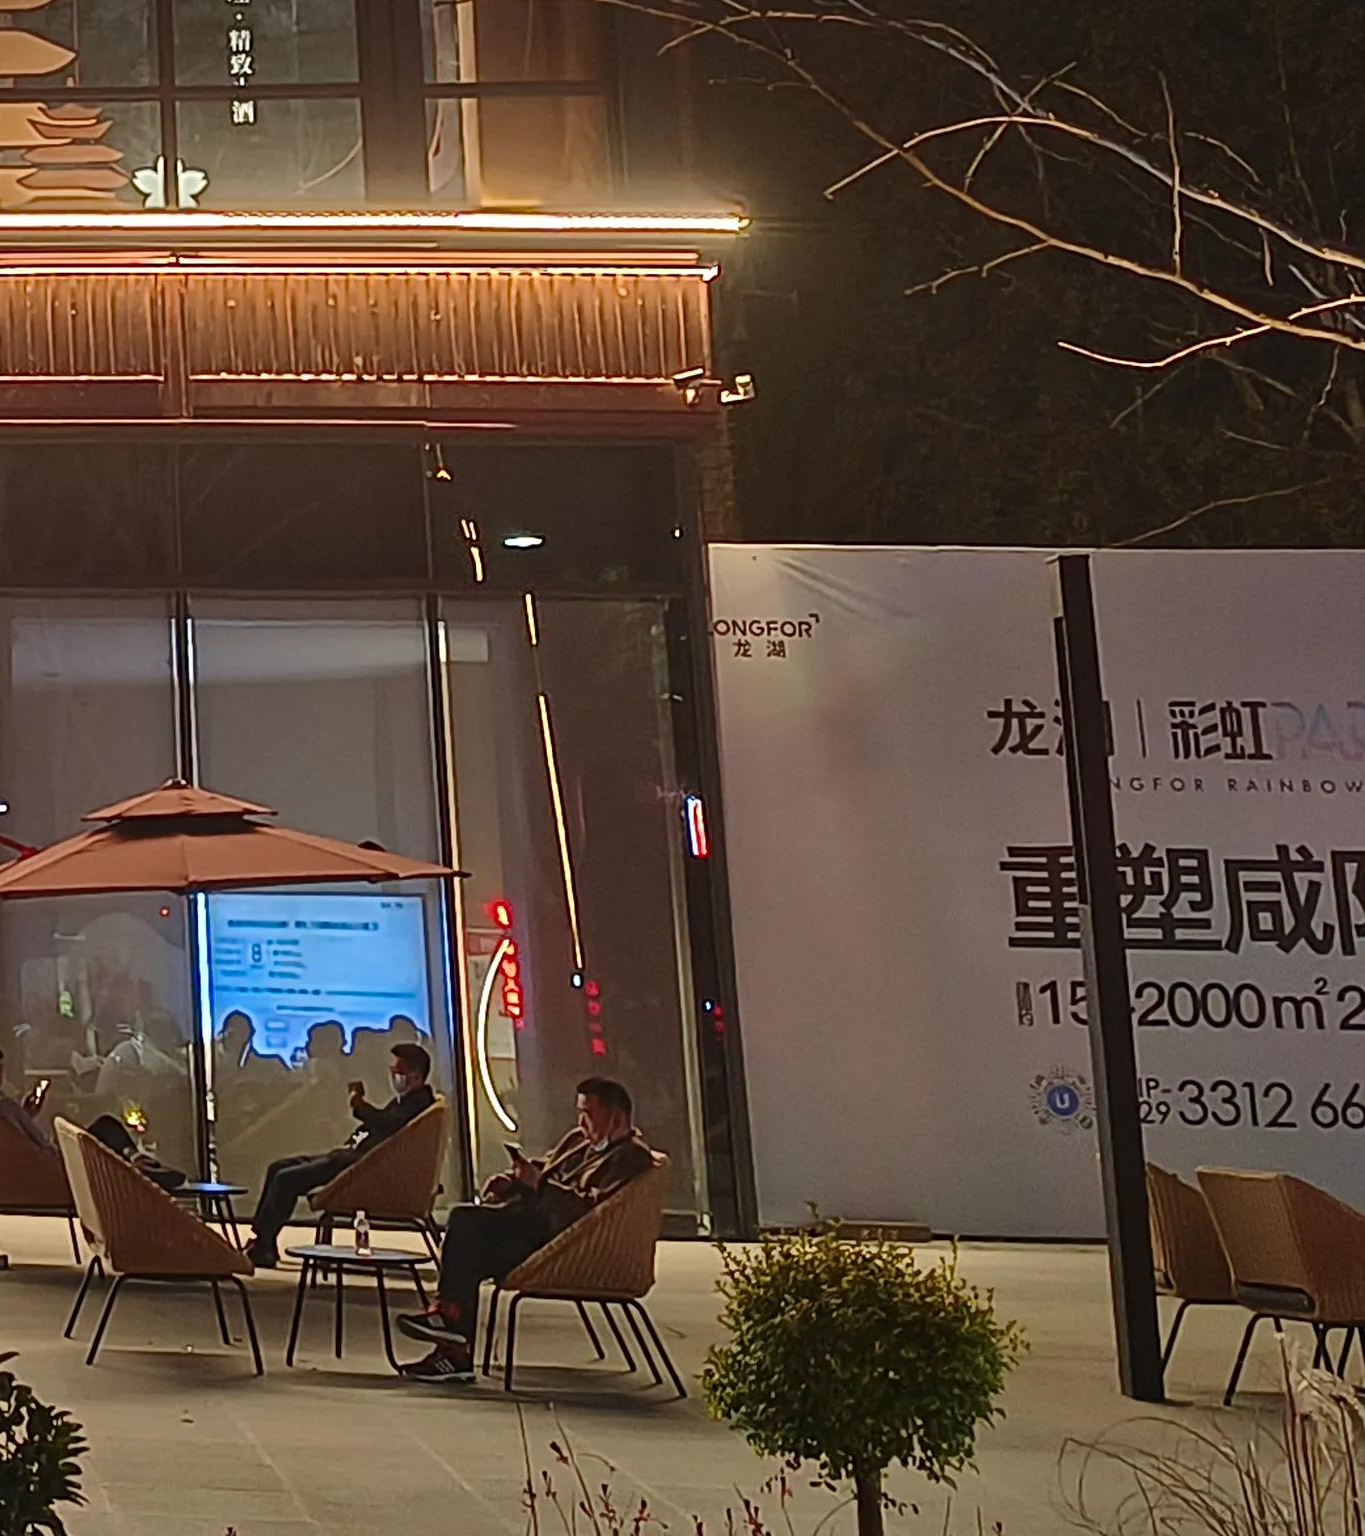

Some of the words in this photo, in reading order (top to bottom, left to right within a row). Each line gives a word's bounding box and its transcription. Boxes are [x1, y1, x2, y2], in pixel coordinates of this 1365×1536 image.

[712, 618, 813, 638] ONGFOR
[1227, 777, 1365, 793] RAINBOW
[1178, 1079, 1298, 1128] 3312
